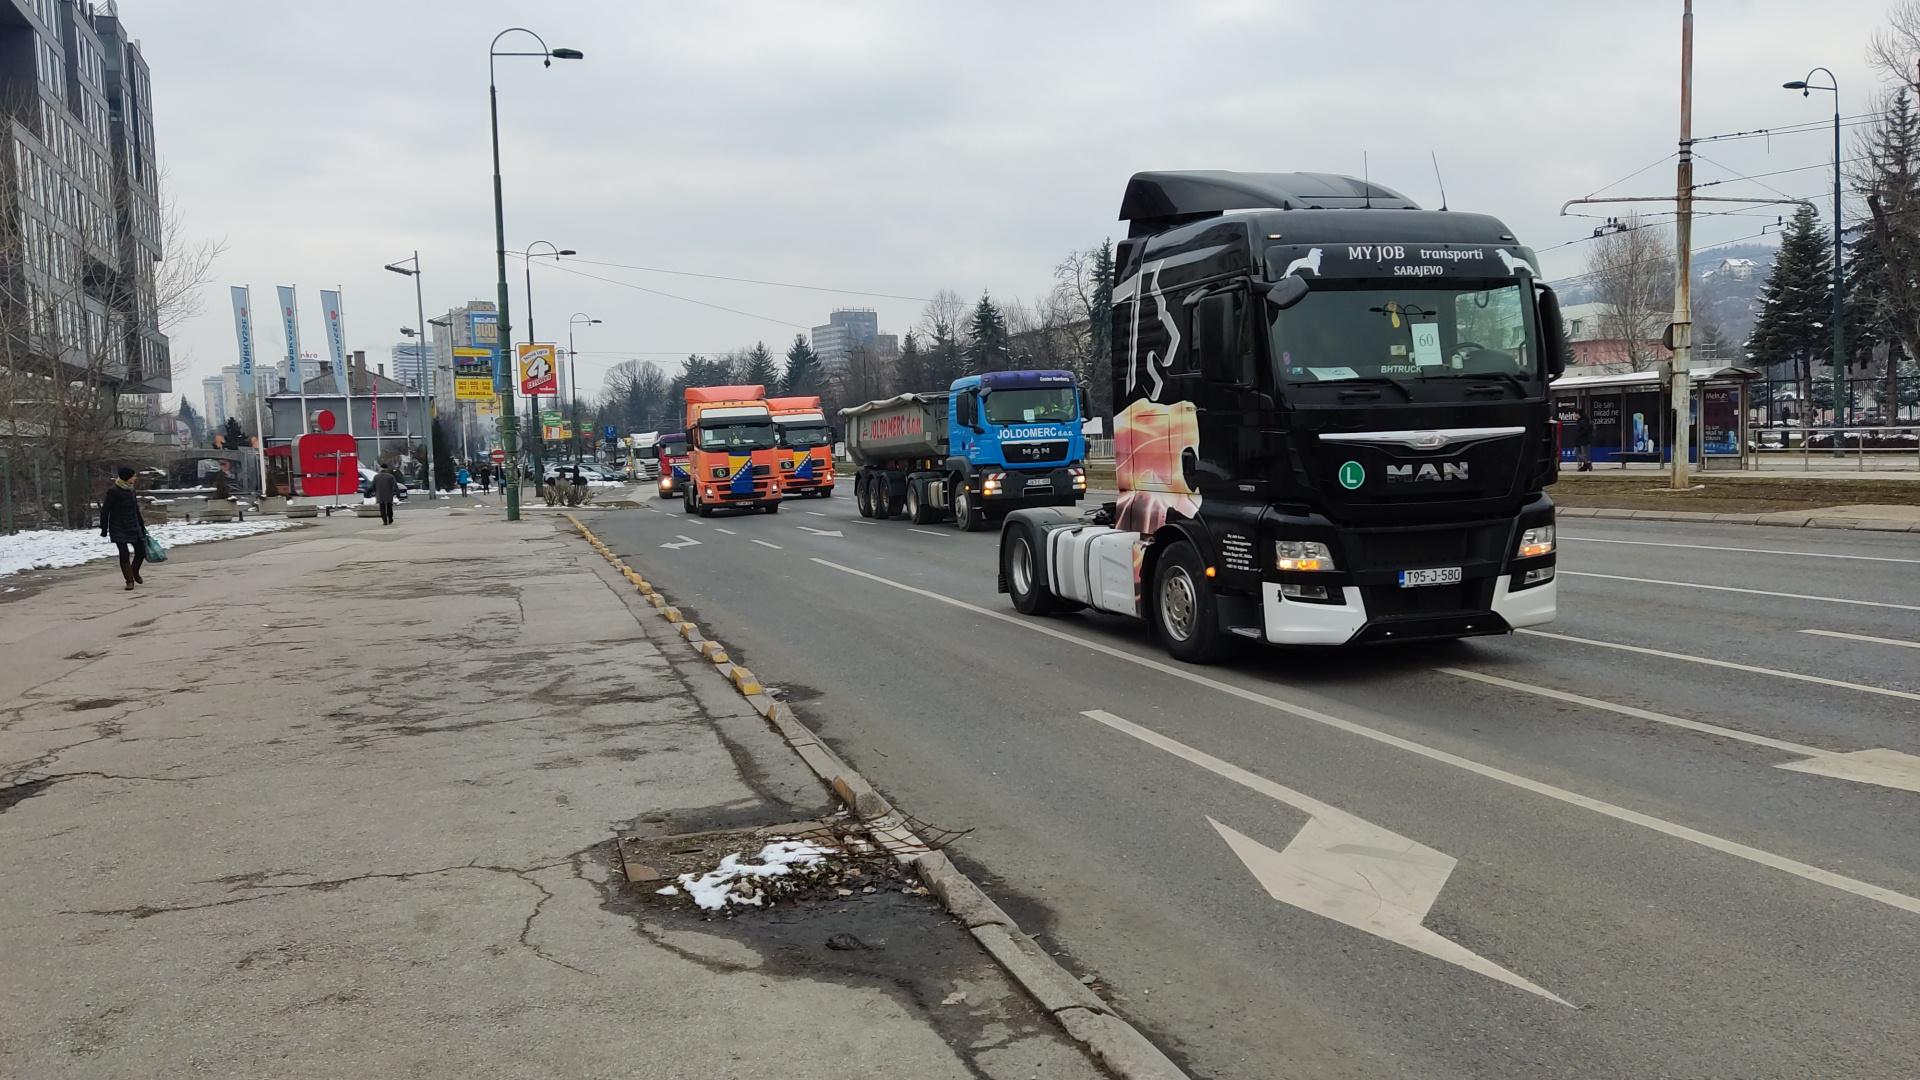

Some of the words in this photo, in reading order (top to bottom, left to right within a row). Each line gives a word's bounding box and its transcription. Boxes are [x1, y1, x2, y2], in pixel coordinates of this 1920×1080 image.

[1348, 246, 1372, 260] MY
[1376, 245, 1405, 263] JOB
[1420, 248, 1484, 262] transporti
[1393, 265, 1443, 277] SARAJEVO
[1419, 333, 1434, 347] 60
[526, 356, 552, 379] 4
[1381, 365, 1423, 374] BHTRUCK
[996, 426, 1058, 440] JOLDOMERC
[1057, 430, 1074, 438] d.o.o.
[1022, 447, 1051, 455] MAN
[1346, 466, 1357, 484] L
[1386, 461, 1469, 483] MAN
[1406, 568, 1461, 584] T95-J-580
